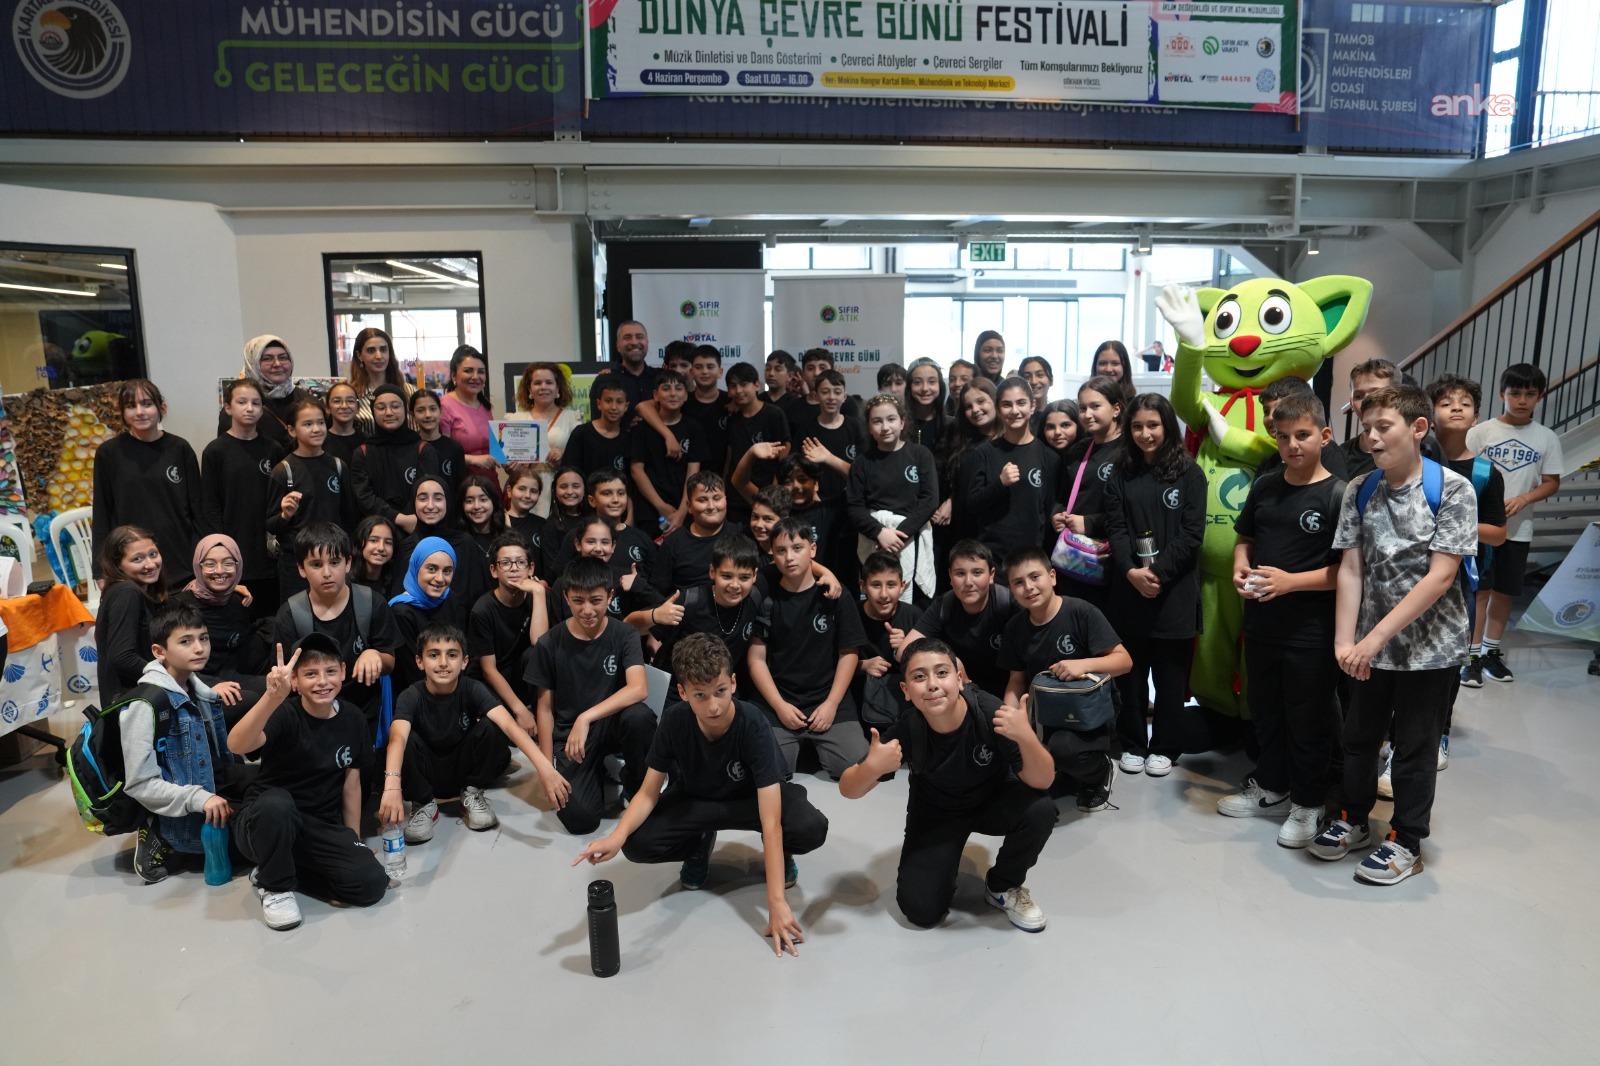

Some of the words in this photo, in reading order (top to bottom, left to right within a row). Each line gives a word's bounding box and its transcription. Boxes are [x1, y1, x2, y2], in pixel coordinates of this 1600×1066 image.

[18, 0, 50, 37] KARTA
[241, 0, 460, 37] MÜHENDİSİN
[470, 3, 564, 38] GÜCÜ
[760, 0, 864, 48] ÇEVRE
[877, 0, 963, 42] GÜNÜ
[976, 2, 1128, 47] FESTİVALİ
[1334, 33, 1375, 46] TMMOB
[664, 50, 692, 64] Müzik
[695, 51, 734, 64] Dinletisi
[737, 54, 748, 64] ve
[750, 52, 773, 65] Dans
[776, 52, 822, 65] Gösterimi
[841, 53, 875, 67] Çevreci
[877, 54, 917, 70] Atölyeler
[1332, 48, 1377, 62] MAKİNA
[933, 55, 966, 69] Çevreci
[969, 57, 1003, 71] Sergiler
[1020, 60, 1038, 71] Tüm
[1040, 61, 1099, 74] Komşularımızı
[1101, 62, 1143, 75] Bekliyoruz
[245, 54, 450, 94] GELECEĞİN
[461, 55, 565, 94] GÜCÜ
[648, 73, 653, 83] 4
[655, 73, 683, 84] Haziran
[685, 73, 722, 86] Perşembe
[745, 74, 762, 84] Saat
[763, 74, 781, 84] 11.00
[789, 74, 808, 85] 16.00
[1332, 64, 1412, 80] MÜHENDİSLERİ
[882, 78, 899, 86] Kartal
[1331, 82, 1364, 94] ODASI
[1330, 95, 1379, 111] İSTANBUL
[1381, 98, 1417, 114] ŞUBESİ
[971, 243, 1005, 261] EXIT
[698, 301, 720, 309] SIFIR
[838, 305, 860, 314] SIFIR
[699, 309, 720, 317] ATIK
[838, 313, 860, 322] ATIK
[832, 351, 855, 362] EVRE
[858, 349, 880, 362] GÜNÜ
[1487, 446, 1509, 458] GAP
[1513, 449, 1539, 463] 1986
